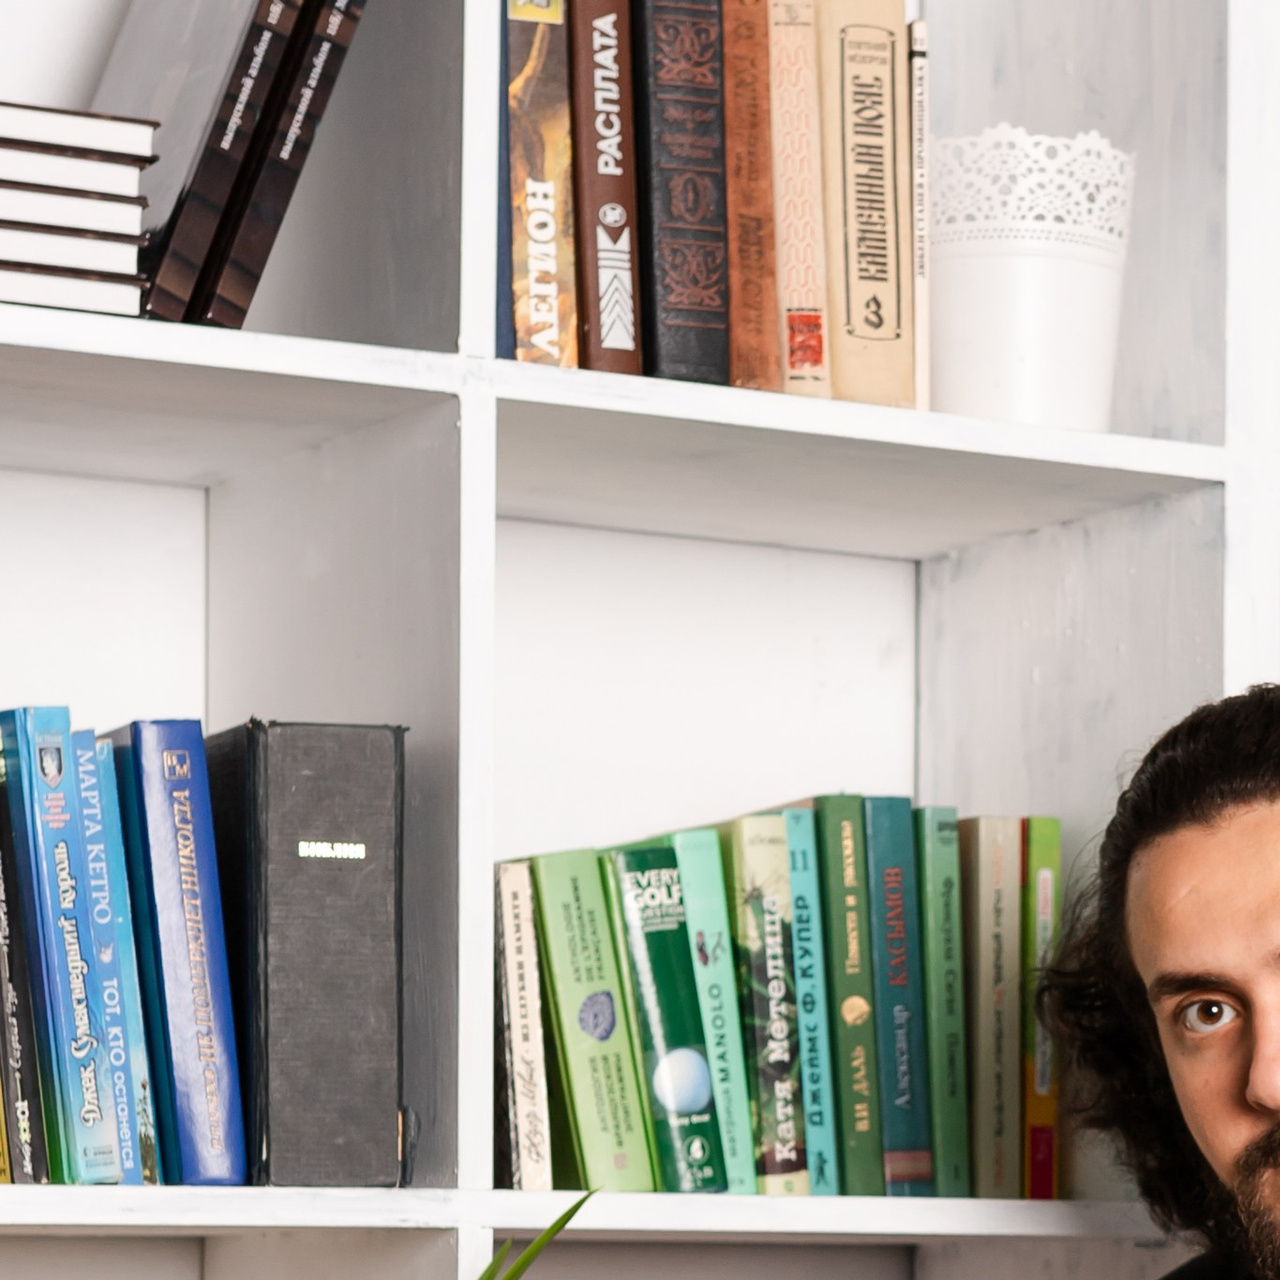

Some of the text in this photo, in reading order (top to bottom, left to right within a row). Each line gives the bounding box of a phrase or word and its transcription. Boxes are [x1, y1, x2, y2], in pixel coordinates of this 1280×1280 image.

[591, 13, 623, 176] РАСПЛАТА
[851, 75, 884, 139] ПОЯС
[525, 178, 559, 358] ЛЕГИОН
[853, 141, 889, 283] КАМЕННЫЙ
[77, 750, 113, 925] МАРТА КЕТРО
[174, 787, 203, 890] НИКОГДА
[624, 868, 682, 893] EVERY
[58, 841, 105, 1128] Джек Сумасшедший король
[795, 894, 815, 980] КУПЕР
[887, 867, 908, 987] КАСЫМОВ
[103, 977, 134, 1169] ТОТ, КТО останется
[707, 984, 731, 1082] MANOLO
[759, 895, 799, 1161] Катя Метелица
[804, 1022, 826, 1127] Джеймс
